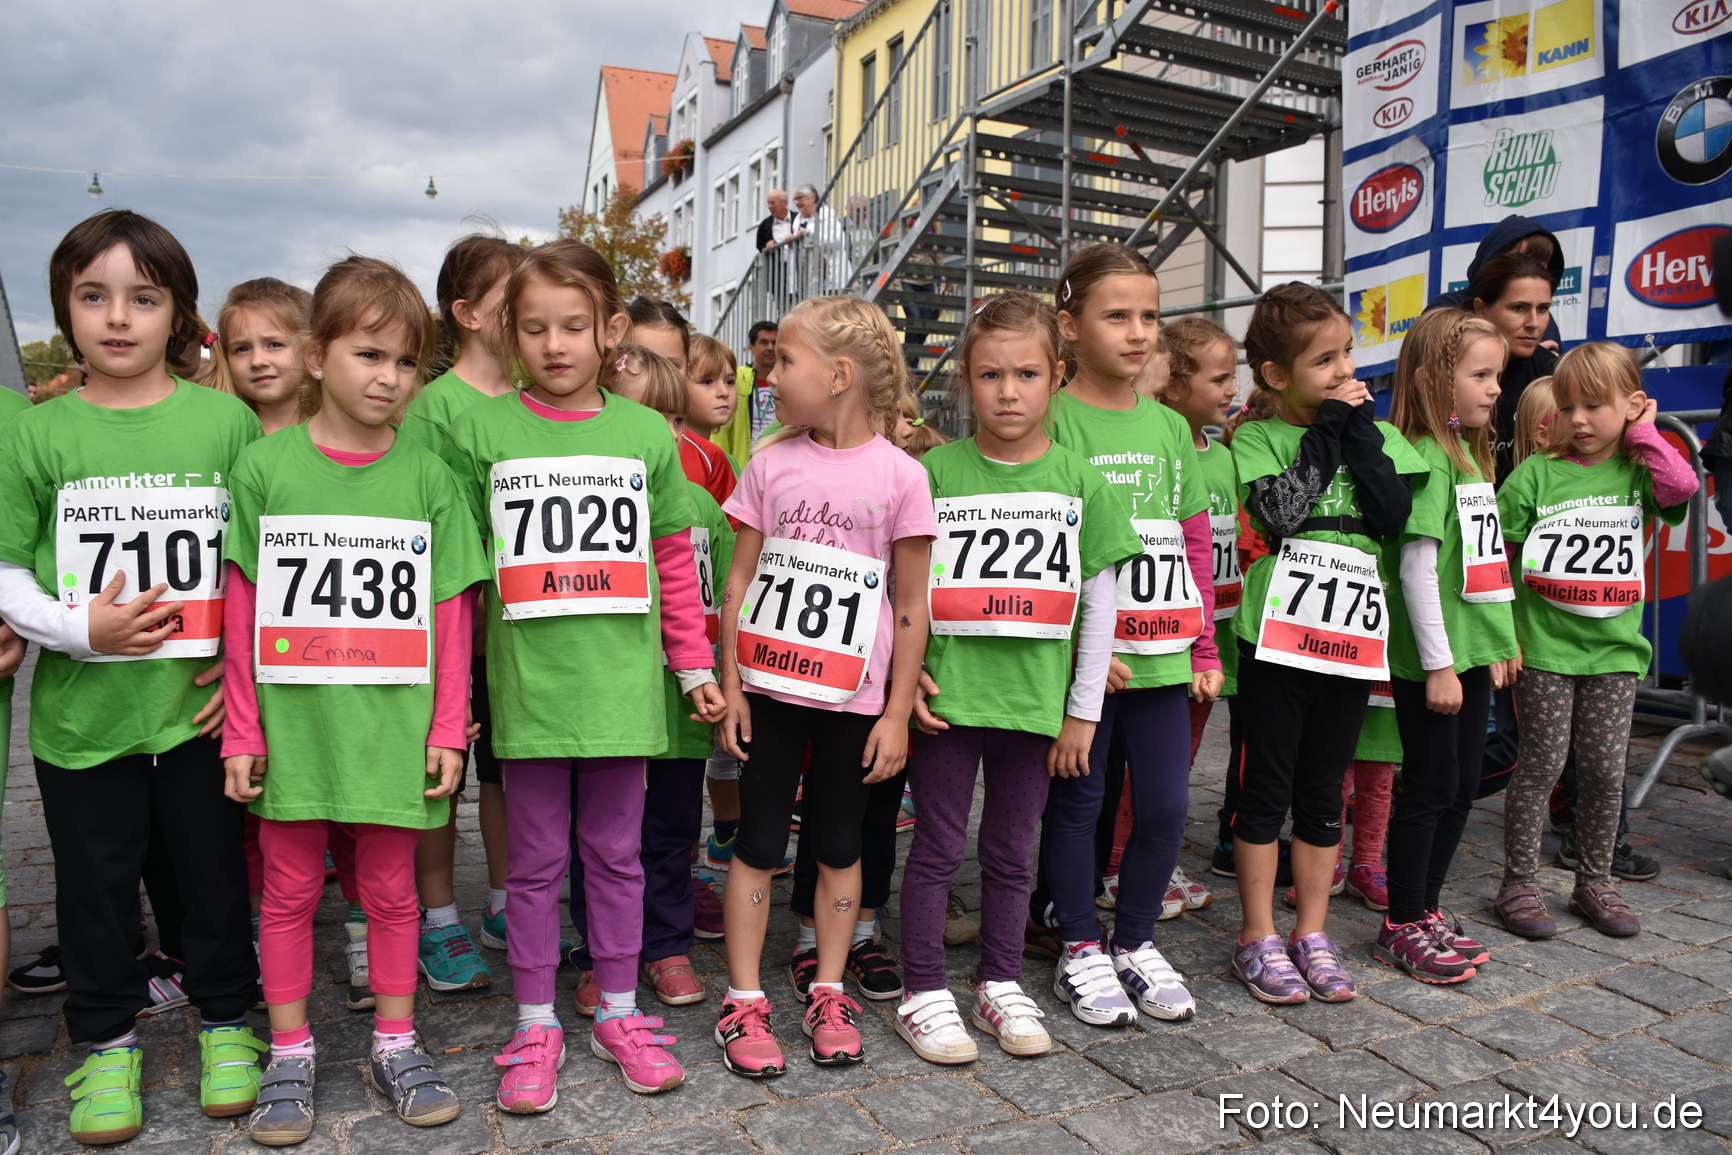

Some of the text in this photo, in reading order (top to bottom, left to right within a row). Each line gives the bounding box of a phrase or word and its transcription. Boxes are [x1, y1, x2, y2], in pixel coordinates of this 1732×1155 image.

[1685, 0, 1728, 29] KIA
[1356, 48, 1414, 79] GERHART
[1537, 37, 1590, 66] KANN
[1384, 57, 1421, 82] JANIG
[1382, 103, 1408, 124] KIA
[1486, 127, 1554, 173] RUND
[1358, 177, 1418, 218] Hervis
[1483, 161, 1562, 208] SCHAU
[1649, 283, 1700, 297] SPORTS
[494, 473, 624, 493] PARTL Neumarkt
[64, 505, 219, 522] PARTL Neumarkt
[779, 500, 853, 530] adidas
[938, 508, 1061, 523] PARTL Neumarkt
[1460, 496, 1486, 508] PARTL
[1537, 495, 1618, 517] Neumarkter
[505, 495, 637, 556] 7029
[1471, 513, 1502, 557] 72
[1534, 517, 1628, 533] PARTL Neumarkt
[265, 533, 405, 550] PARTL Neumarkt
[949, 528, 1070, 583] 7224
[1539, 534, 1634, 575] 7225
[79, 529, 223, 594] 7101
[760, 552, 858, 582] PARTL Neumarkt
[1282, 551, 1376, 579] PARTL Neumarkt
[278, 558, 417, 620] 7438
[542, 569, 612, 593] Anouk
[1527, 579, 1639, 603] Felicitas Klara
[750, 573, 861, 646] 7181
[983, 595, 1033, 616] Julia
[1286, 570, 1382, 631] 7175
[1125, 616, 1180, 639] Sophia
[303, 636, 376, 663] Emma
[753, 643, 823, 678] Madlen
[1298, 633, 1358, 660] Juanita
